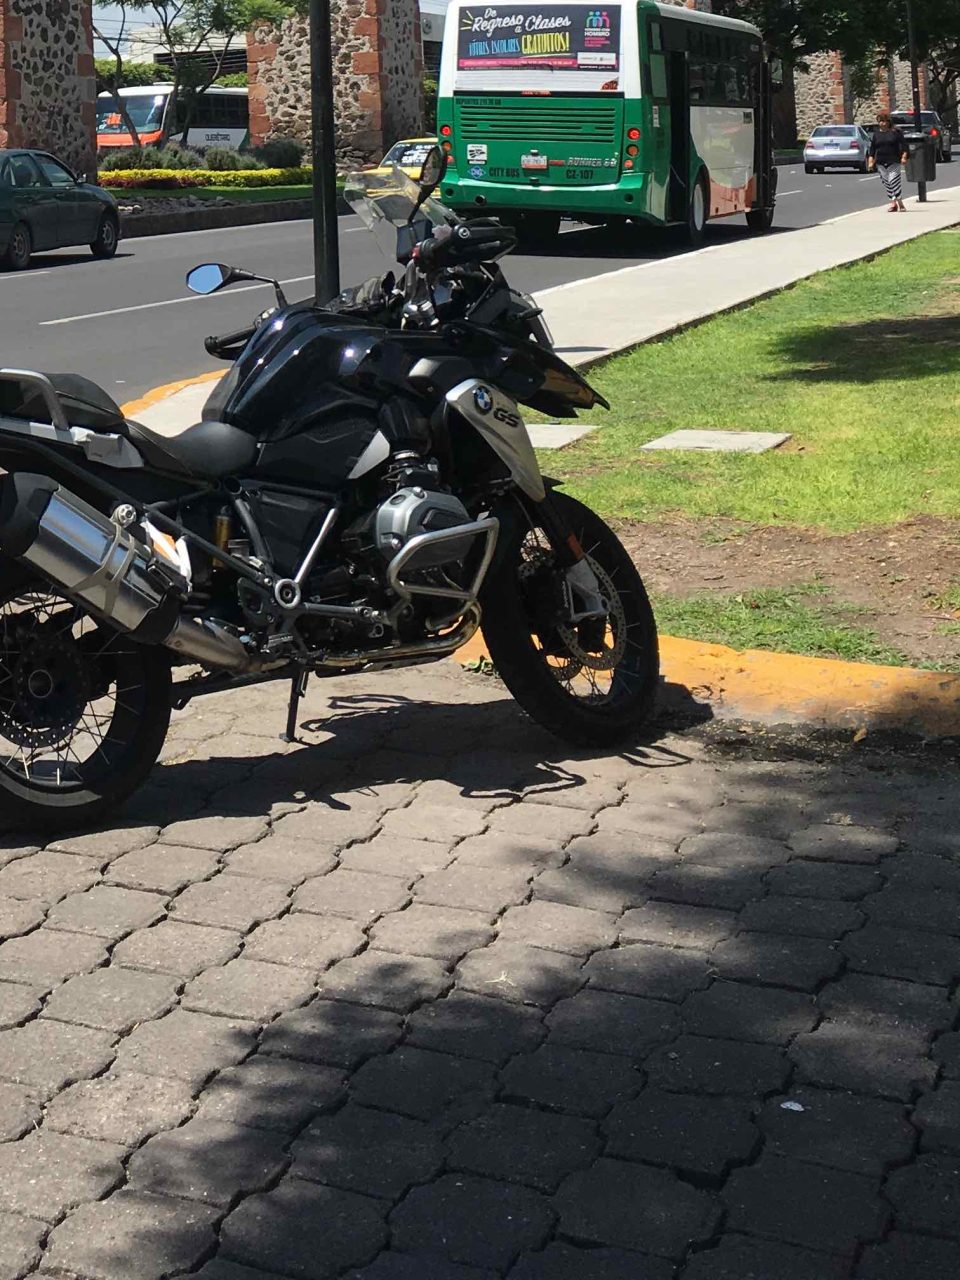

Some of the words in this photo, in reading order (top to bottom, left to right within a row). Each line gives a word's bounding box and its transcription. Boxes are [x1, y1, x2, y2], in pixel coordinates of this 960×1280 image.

[484, 7, 497, 18] De
[472, 14, 524, 37] Regreso
[515, 25, 523, 33] a
[525, 15, 571, 31] Clases
[522, 32, 570, 54] GRATUITOS!
[489, 167, 504, 177] CITY
[506, 167, 520, 178] BUS
[493, 407, 520, 428] GS
